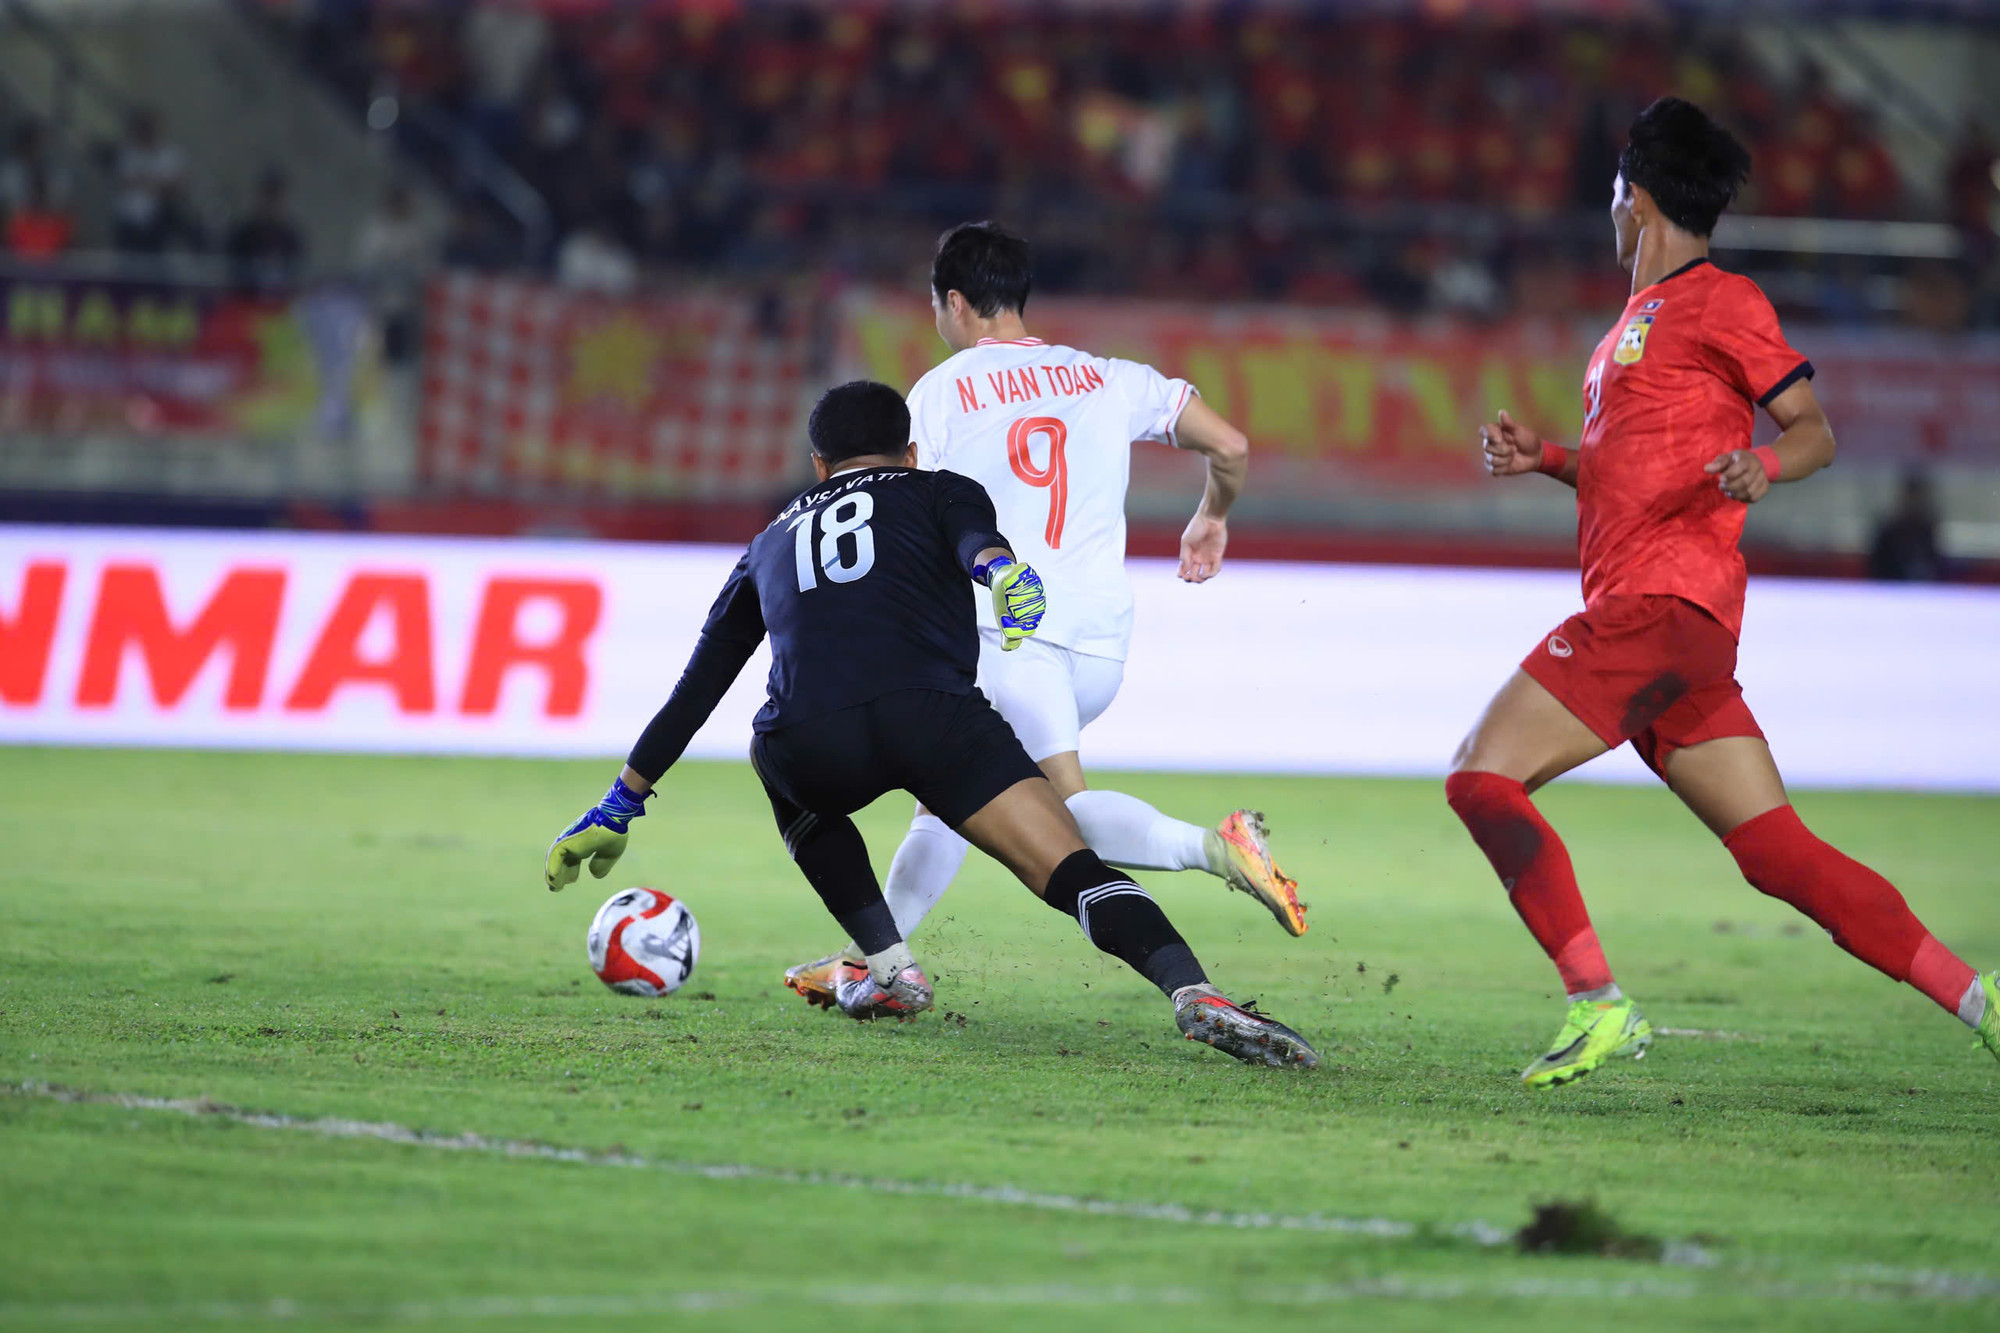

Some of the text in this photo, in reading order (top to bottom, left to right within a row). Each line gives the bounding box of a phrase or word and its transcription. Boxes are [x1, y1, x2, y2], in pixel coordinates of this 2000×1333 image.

[956, 364, 1104, 413] N. VAN TOAN
[1007, 416, 1067, 549] 9
[786, 491, 875, 592] 18
